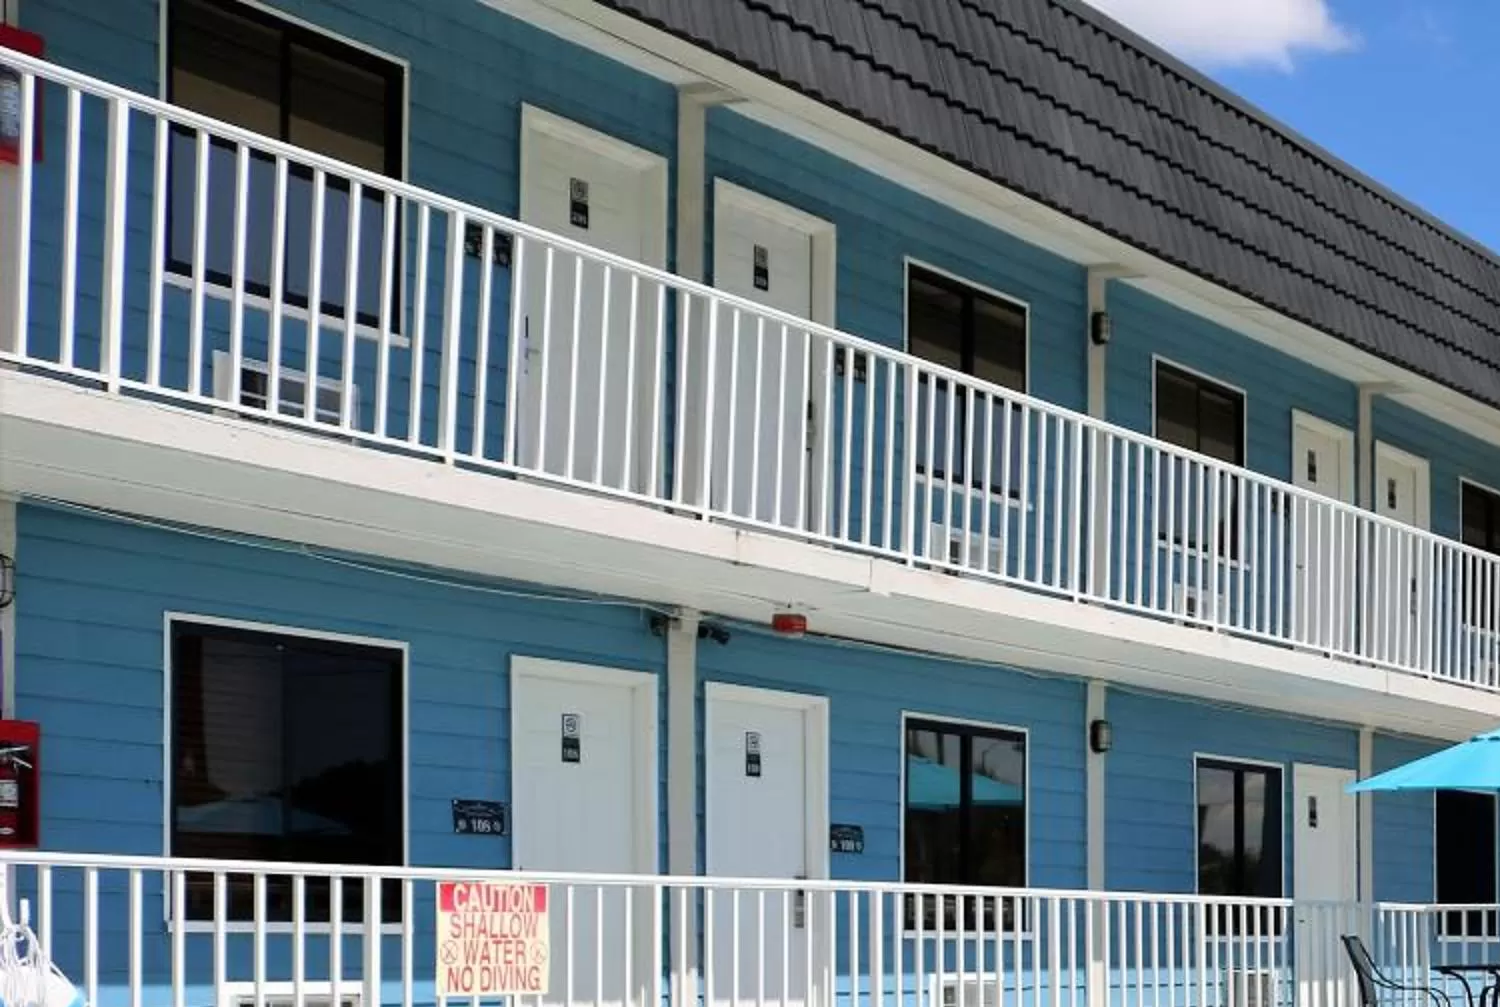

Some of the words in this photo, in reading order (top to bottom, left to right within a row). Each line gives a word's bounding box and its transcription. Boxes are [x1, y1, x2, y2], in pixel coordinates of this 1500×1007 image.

[453, 884, 534, 912] CAUTION
[450, 913, 539, 939] SHALLOW
[463, 939, 527, 965] WATER
[447, 966, 474, 992] NO
[479, 965, 541, 992] DIVING
